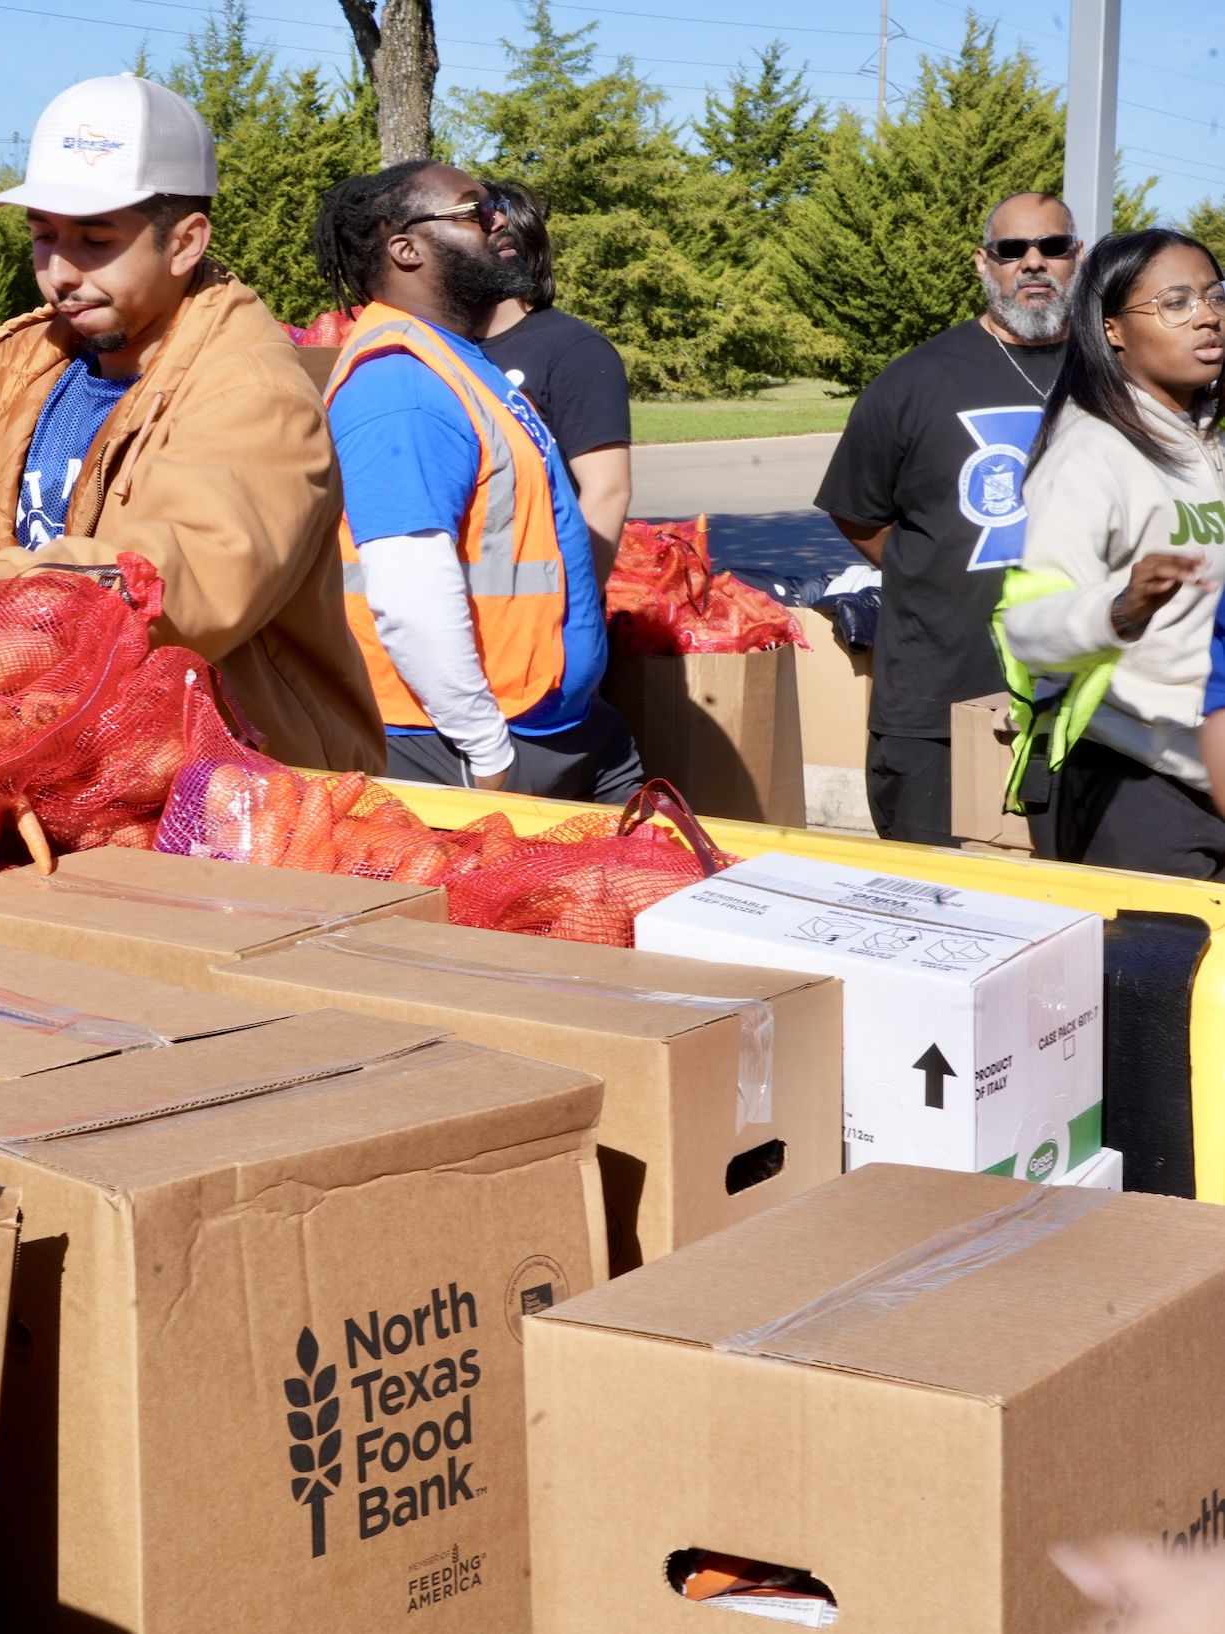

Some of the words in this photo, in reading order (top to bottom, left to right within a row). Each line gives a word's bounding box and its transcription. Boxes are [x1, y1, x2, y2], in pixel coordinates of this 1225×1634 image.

[689, 894, 720, 905] KEEP
[719, 902, 765, 916] FROZEN
[702, 890, 771, 910] PERISHABLE
[1038, 1030, 1057, 1050] CASE
[1058, 1019, 1077, 1040] PACK
[975, 1054, 1013, 1081] PRODUCT
[986, 1074, 1008, 1096] ITALY
[1029, 1148, 1054, 1173] Great
[344, 1281, 478, 1369] North
[350, 1348, 482, 1423] Texas
[356, 1394, 473, 1484] Food
[408, 1554, 481, 1596] FEEDING
[407, 1572, 483, 1614] AMERICA
